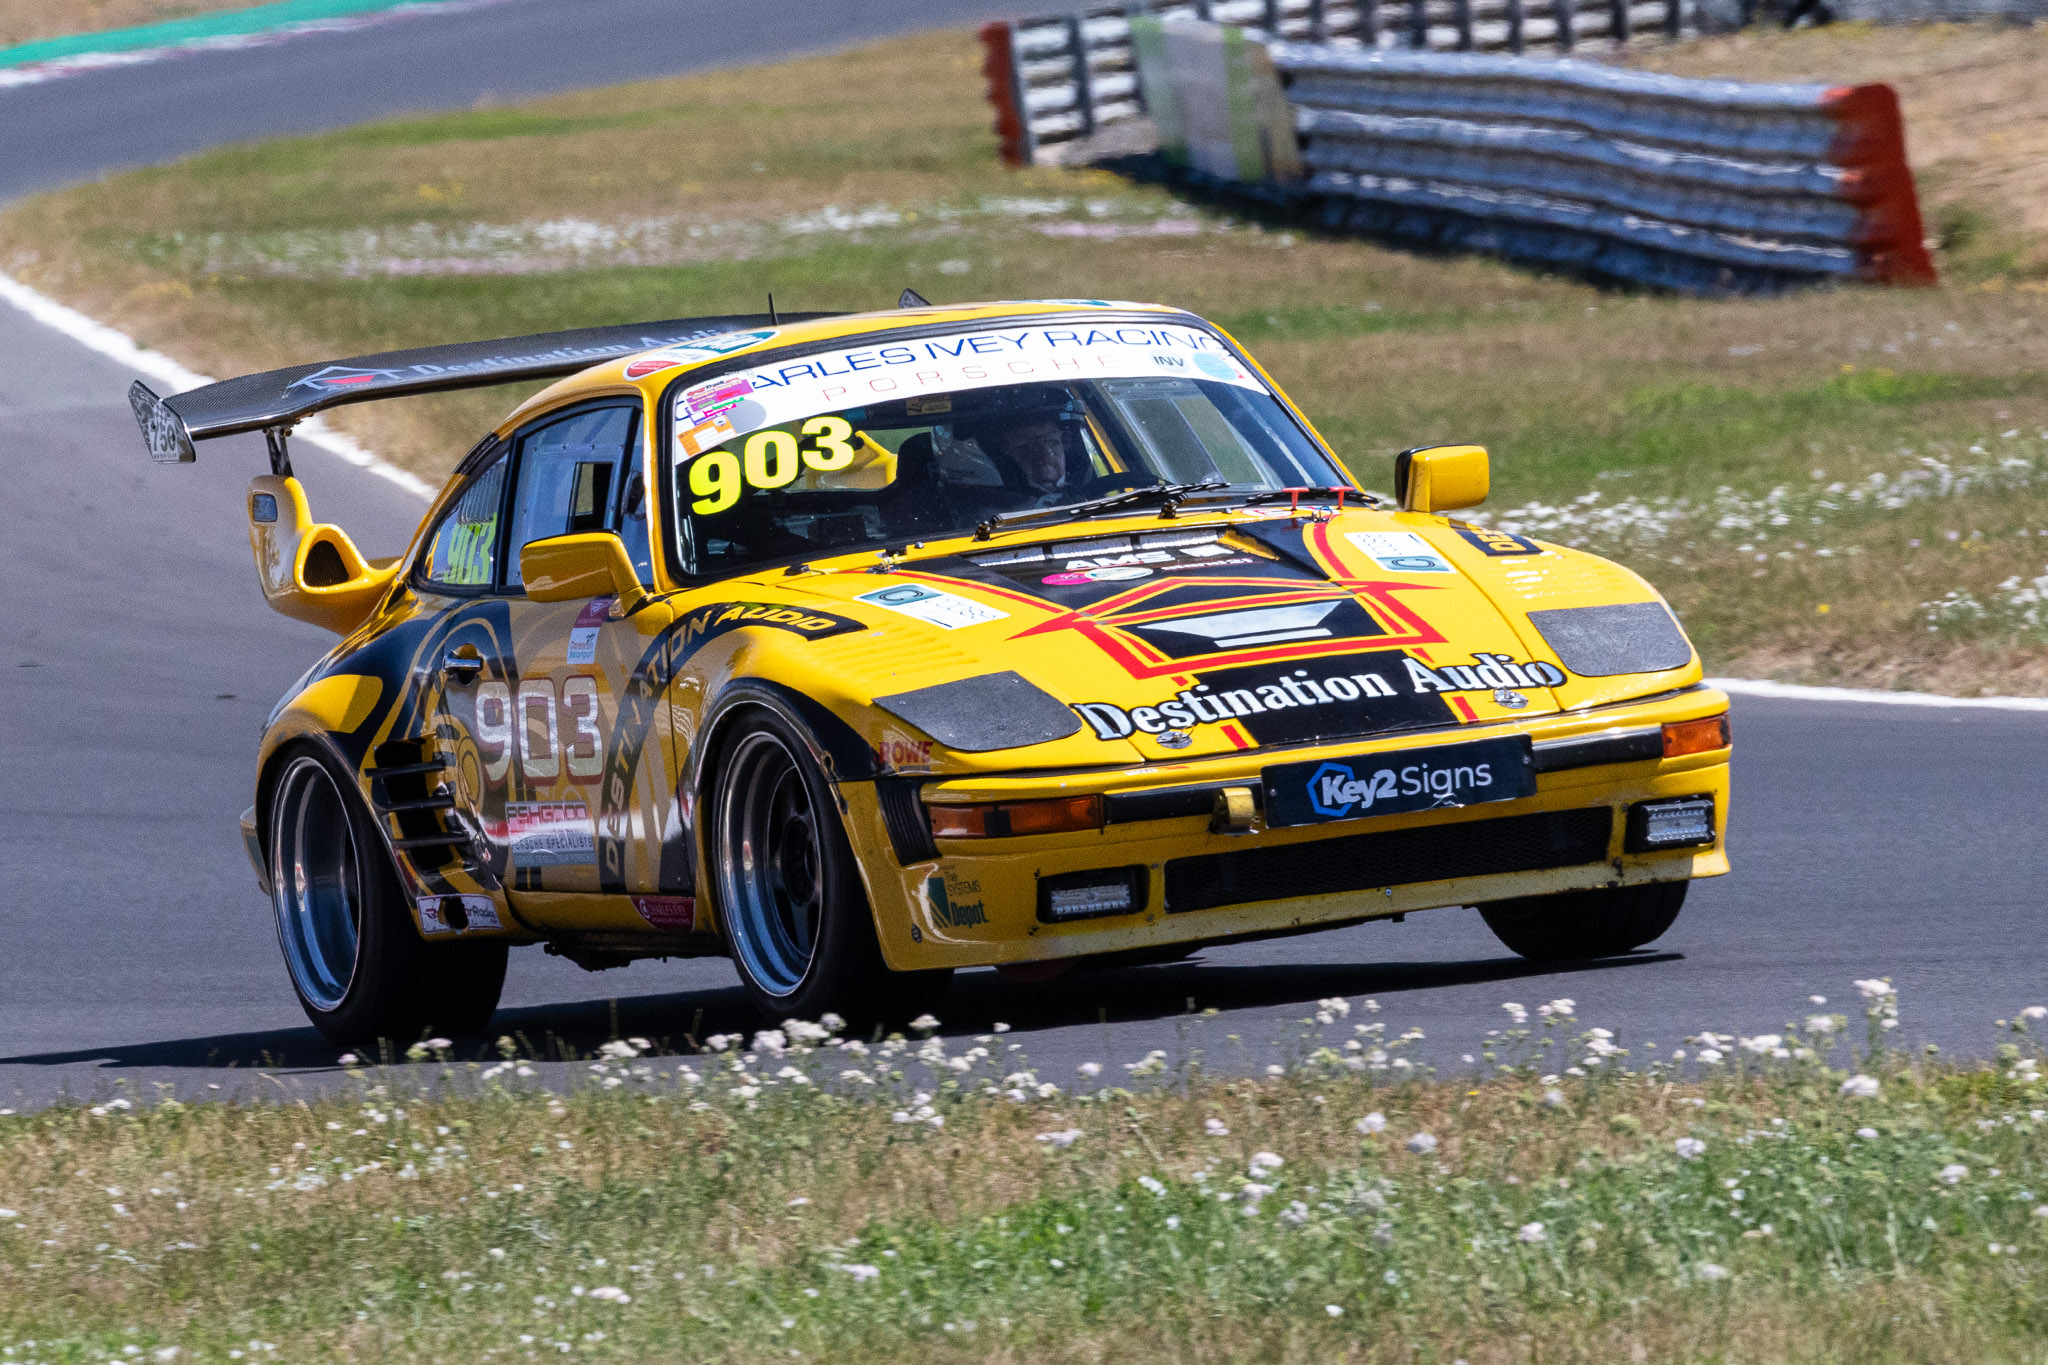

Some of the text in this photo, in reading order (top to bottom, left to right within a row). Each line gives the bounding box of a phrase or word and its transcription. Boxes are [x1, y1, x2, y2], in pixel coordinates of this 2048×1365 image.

[408, 343, 633, 375] Destination
[924, 331, 1030, 360] IVEY
[1153, 355, 1184, 368] INV
[823, 356, 1122, 402] PORSCHE
[689, 416, 854, 514] 903
[443, 512, 497, 584] 903
[1065, 550, 1176, 570] AMS
[1080, 653, 1566, 740] Destination Audio
[476, 676, 604, 788] 903
[605, 606, 838, 877] DESTINATION AUDIO
[878, 741, 934, 763] ROWE
[546, 837, 592, 850] SPECIALISTS
[944, 871, 958, 883] The
[947, 880, 982, 897] SYSTEMS
[950, 900, 989, 928] Depot
